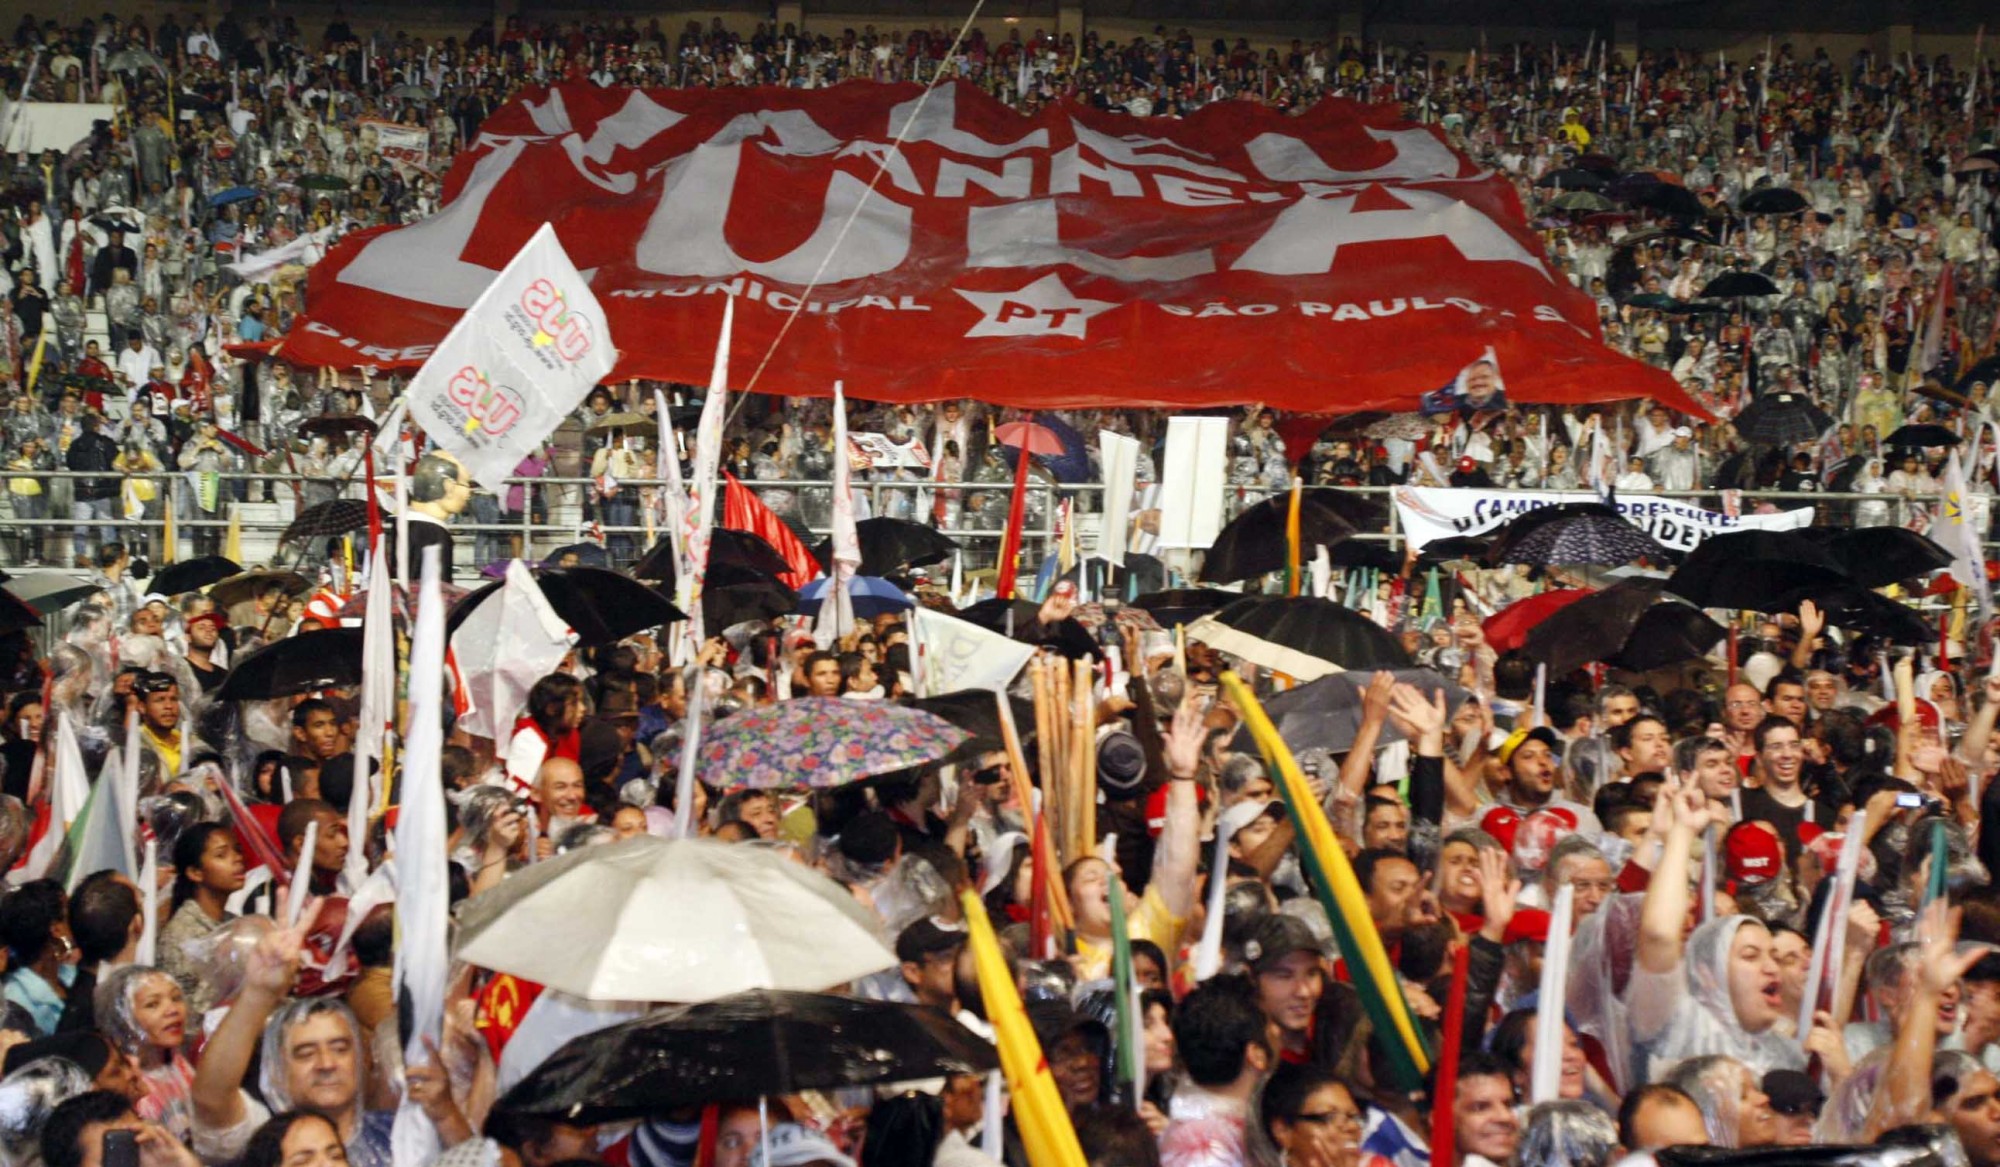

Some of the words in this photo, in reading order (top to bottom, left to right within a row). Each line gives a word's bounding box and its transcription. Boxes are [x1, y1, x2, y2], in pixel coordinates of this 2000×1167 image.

[336, 135, 1555, 310] LULA
[305, 321, 435, 362] DIRE
[610, 277, 931, 314] MUNICIPAL
[995, 300, 1081, 329] PT
[1474, 499, 1557, 514] CAMP
